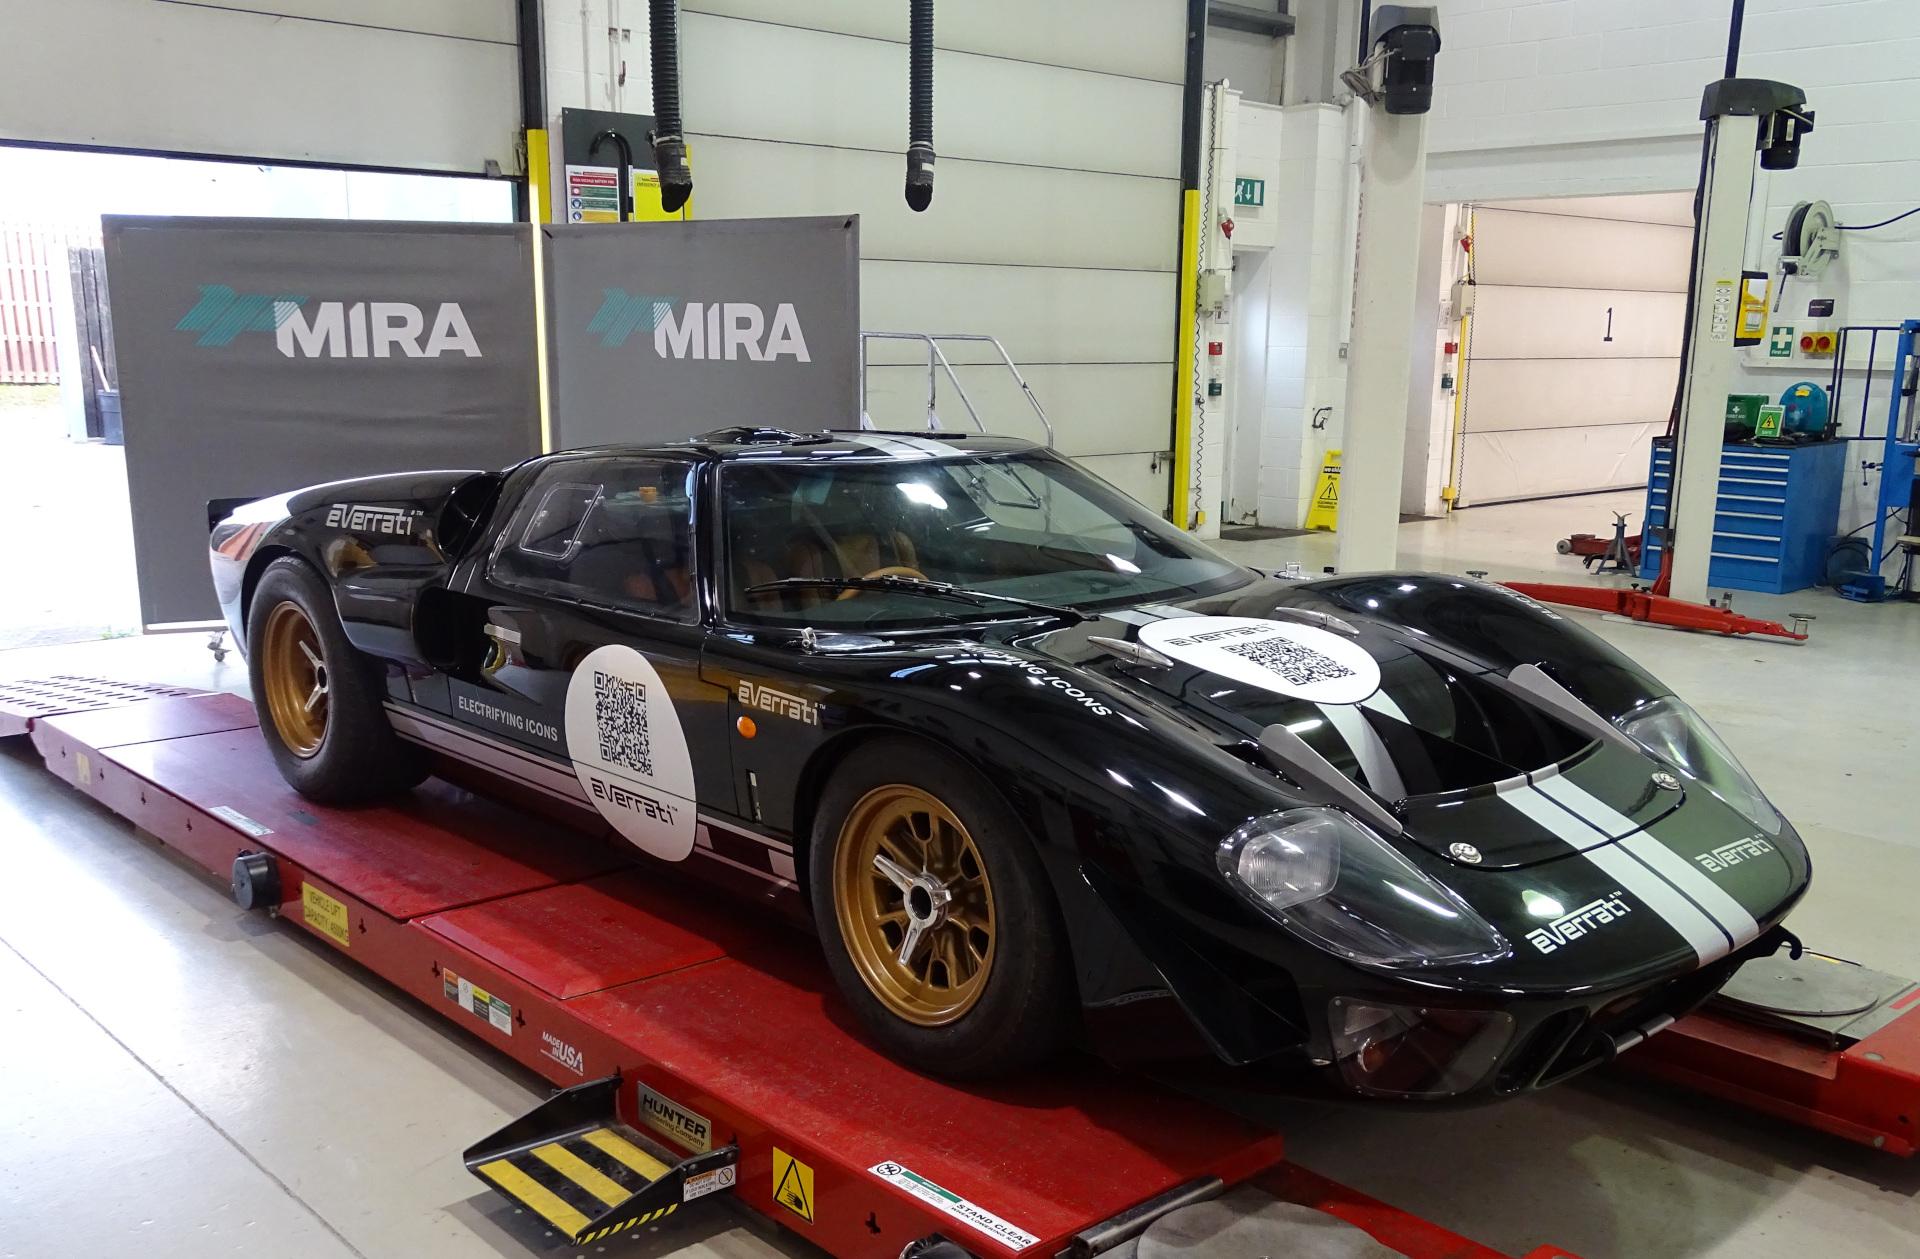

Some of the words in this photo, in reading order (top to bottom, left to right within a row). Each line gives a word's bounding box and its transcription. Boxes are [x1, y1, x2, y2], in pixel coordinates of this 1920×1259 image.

[273, 302, 482, 357] MIRA
[653, 302, 811, 362] MIRA
[1603, 307, 1613, 342] 1
[1043, 676, 1112, 716] ICONS
[458, 695, 523, 730] ELECTRIFYING
[525, 718, 558, 742] ICONS
[542, 1031, 560, 1048] MADE
[559, 1041, 584, 1072] USA
[642, 1094, 706, 1139] HUNTER
[675, 1126, 705, 1148] Company
[956, 1204, 992, 1225] STAND
[994, 1224, 1032, 1246] CLEAR
